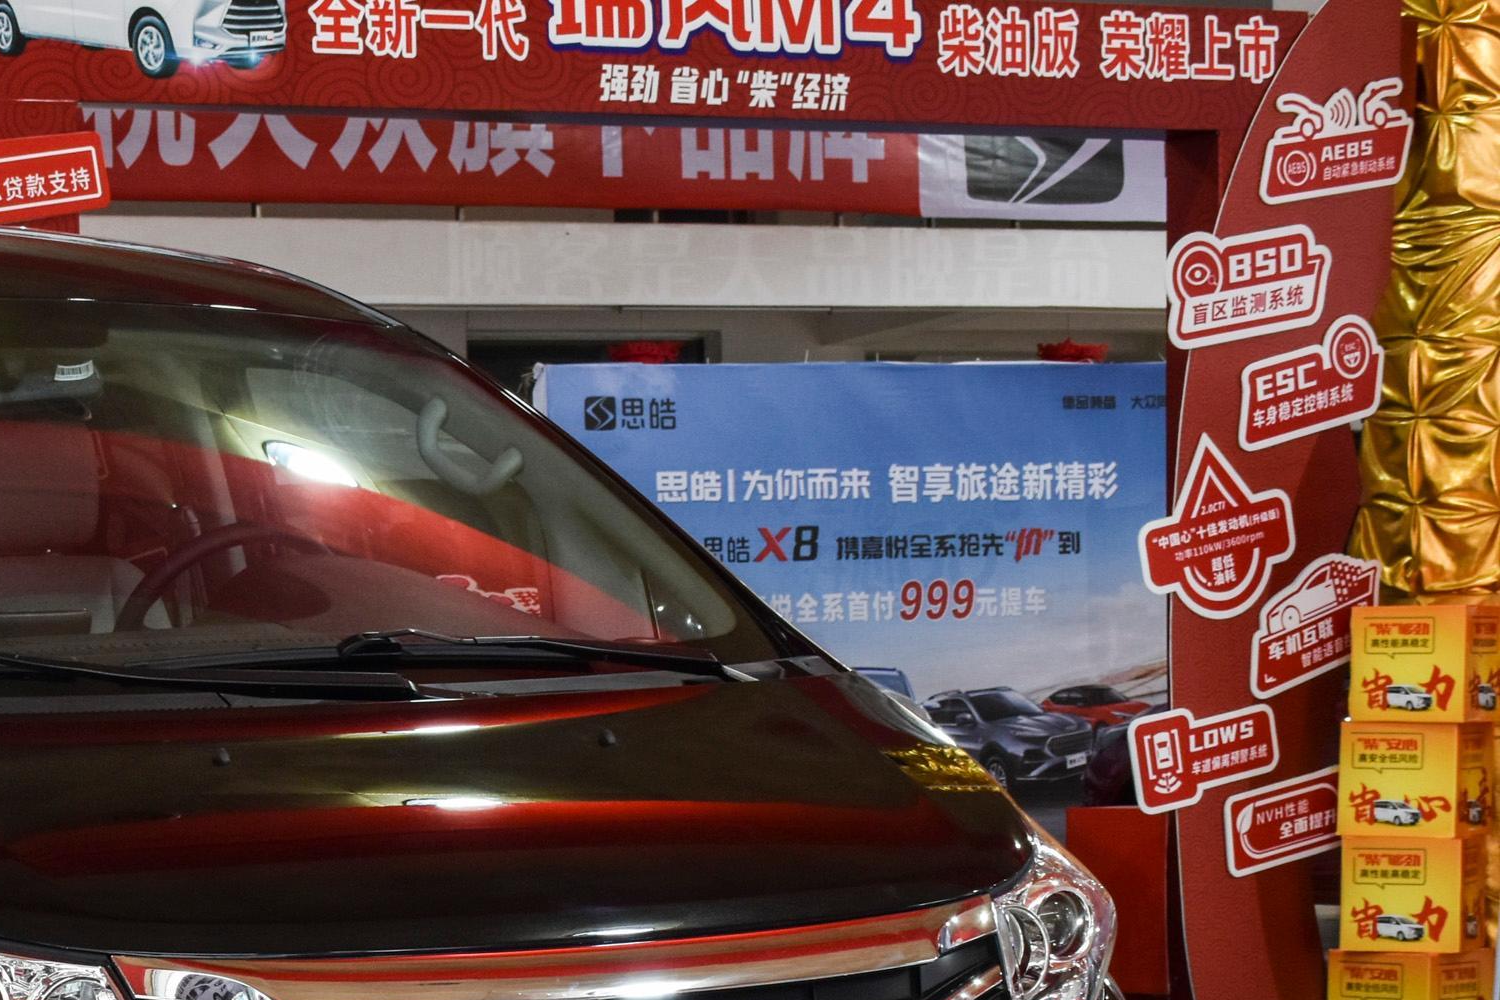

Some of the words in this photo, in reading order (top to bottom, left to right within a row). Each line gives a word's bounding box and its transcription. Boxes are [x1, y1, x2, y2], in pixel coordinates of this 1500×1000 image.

[308, 0, 529, 60] 全新一代
[938, 5, 1080, 78] 柴油版
[1100, 11, 1278, 84] 荣耀上市
[599, 63, 659, 103] 强劲
[1321, 139, 1373, 162] AEBS
[1229, 243, 1303, 284] BSD
[1191, 285, 1304, 326] 盲区监测系统
[1256, 361, 1317, 402] ESC
[621, 397, 677, 431] 思皓
[1252, 382, 1354, 428] 车身稳定控制系统
[889, 460, 1119, 504] 智享旅途新精彩
[766, 577, 1047, 623] 悦全系首付999元提车
[1268, 617, 1334, 660] 车机互联
[1189, 719, 1254, 752] LDWS
[1256, 799, 1309, 825] NVH性能
[1279, 808, 1336, 839] 全面提升
